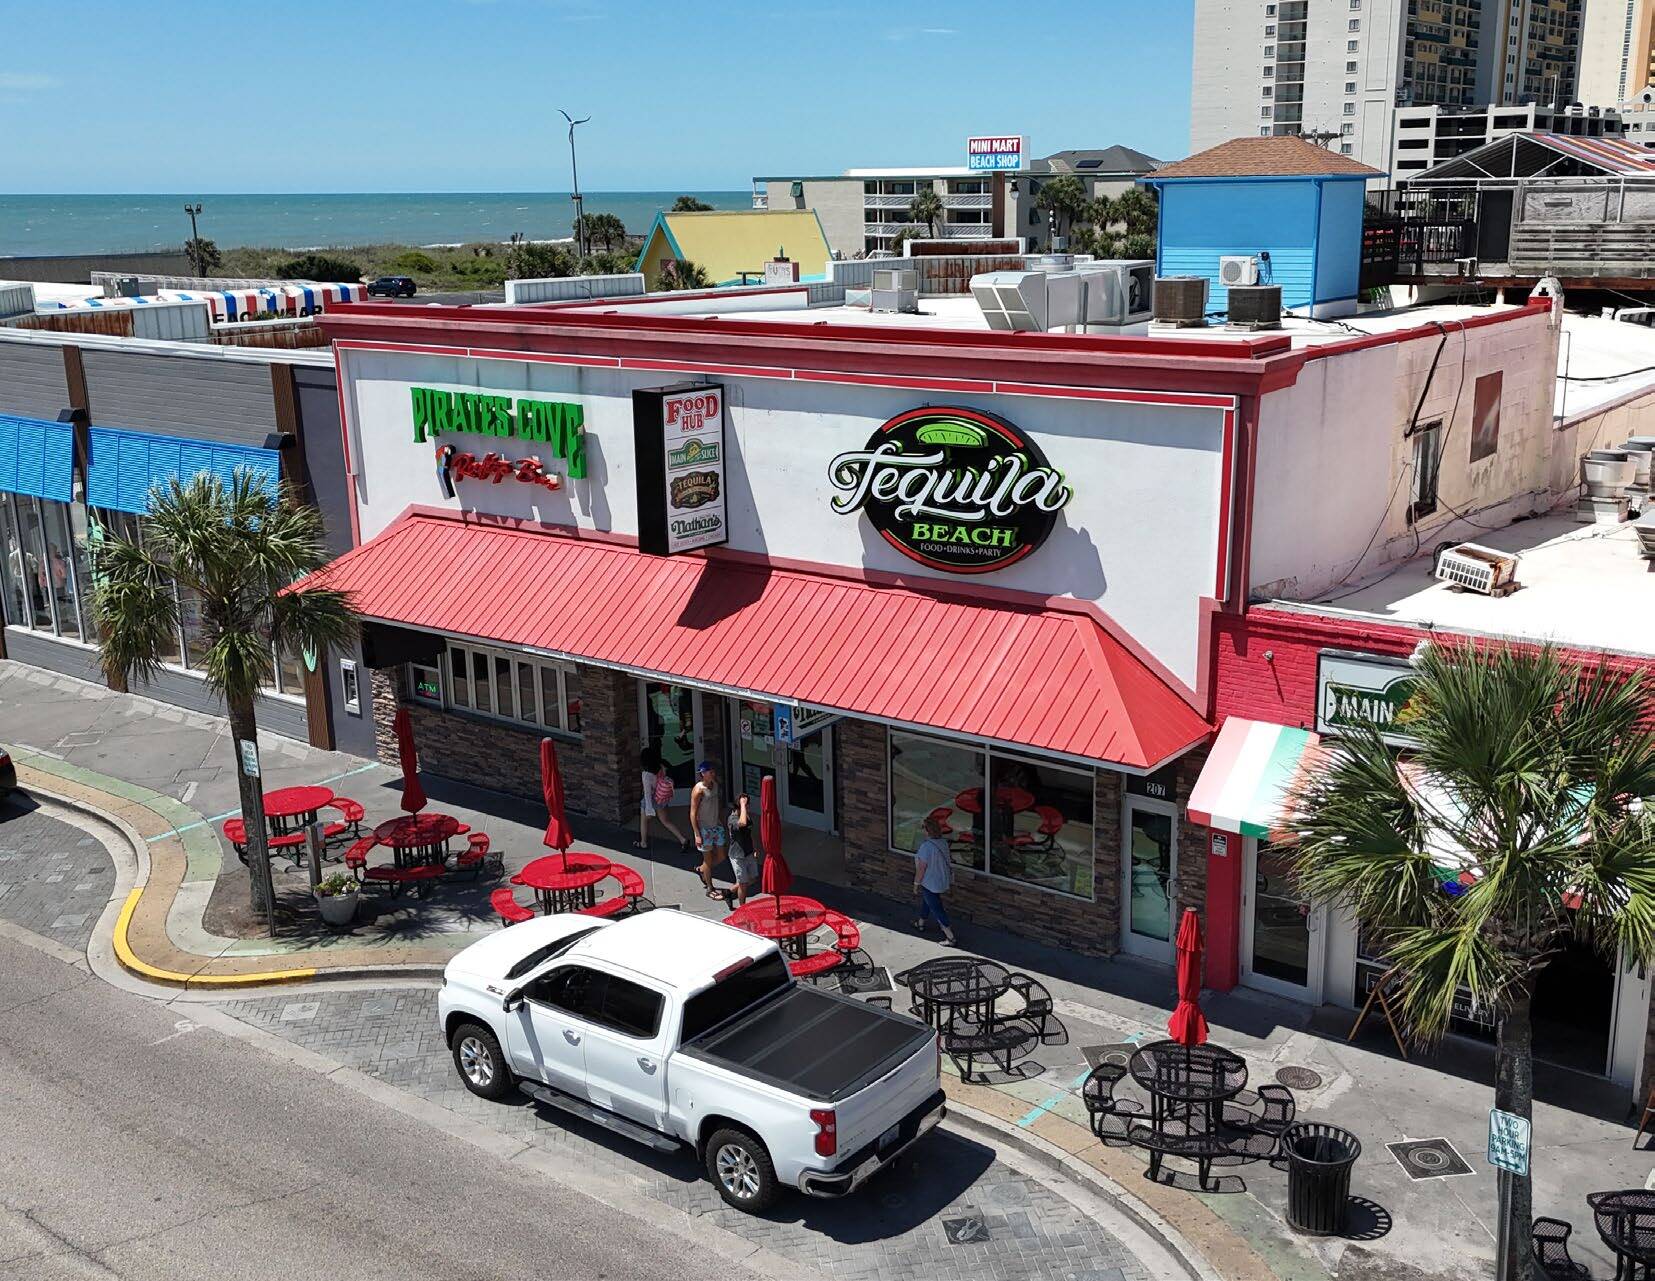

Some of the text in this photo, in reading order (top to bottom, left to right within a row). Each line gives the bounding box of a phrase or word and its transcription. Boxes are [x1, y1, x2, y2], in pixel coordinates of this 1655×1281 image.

[970, 139, 1019, 153] MINI MART
[970, 155, 1018, 169] BEACH SHOP
[665, 394, 719, 425] FOOD
[681, 412, 704, 431] HUB
[410, 387, 587, 479] PIRATES COVE
[670, 447, 716, 464] MAIN SLICE
[678, 476, 712, 489] TEQUILA
[828, 440, 1073, 522] Tequila
[671, 514, 722, 535] Nathan's
[911, 523, 1013, 547] BEACH
[920, 543, 1002, 557] FOOD DRINKS PARTY
[417, 682, 437, 693] ATM
[1340, 694, 1395, 725] MAIN
[1454, 1003, 1490, 1018] ELIVERY
[1500, 1116, 1519, 1129] TWO
[1497, 1127, 1520, 1139] HOUR
[1491, 1134, 1525, 1151] PARKING
[1491, 1143, 1526, 1161] 9AM-5PM
